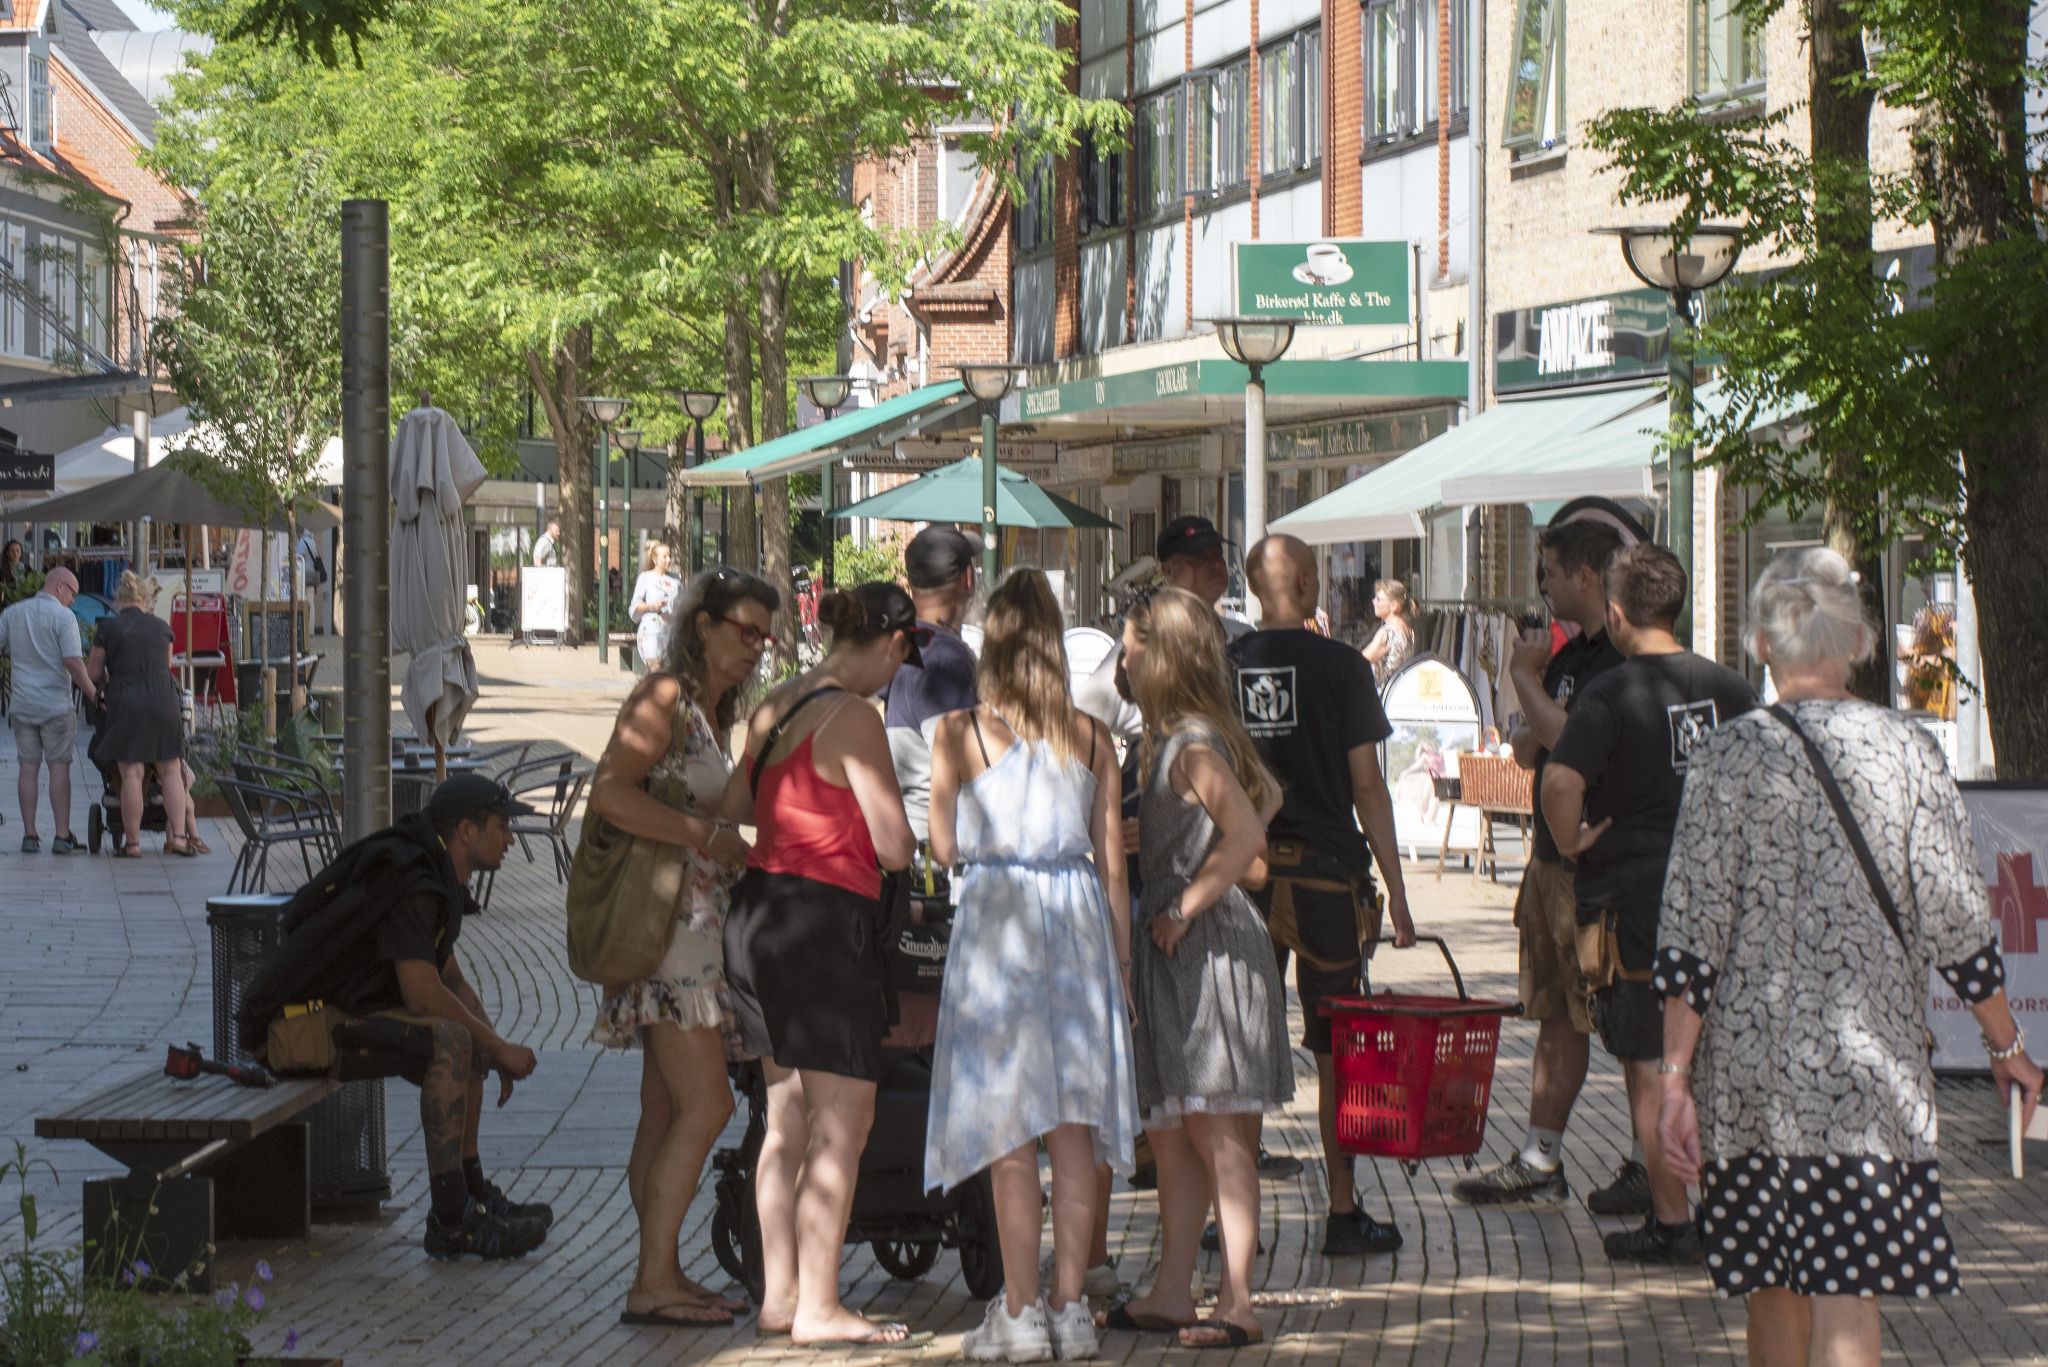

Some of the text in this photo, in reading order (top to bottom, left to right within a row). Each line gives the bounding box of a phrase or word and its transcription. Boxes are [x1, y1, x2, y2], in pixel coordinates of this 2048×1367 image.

[1255, 291, 1391, 309] Birkerød Kaffe & The
[1538, 300, 1615, 375] AMAZE
[1095, 380, 1105, 405] VIN
[2009, 996, 2048, 1012] ORS
